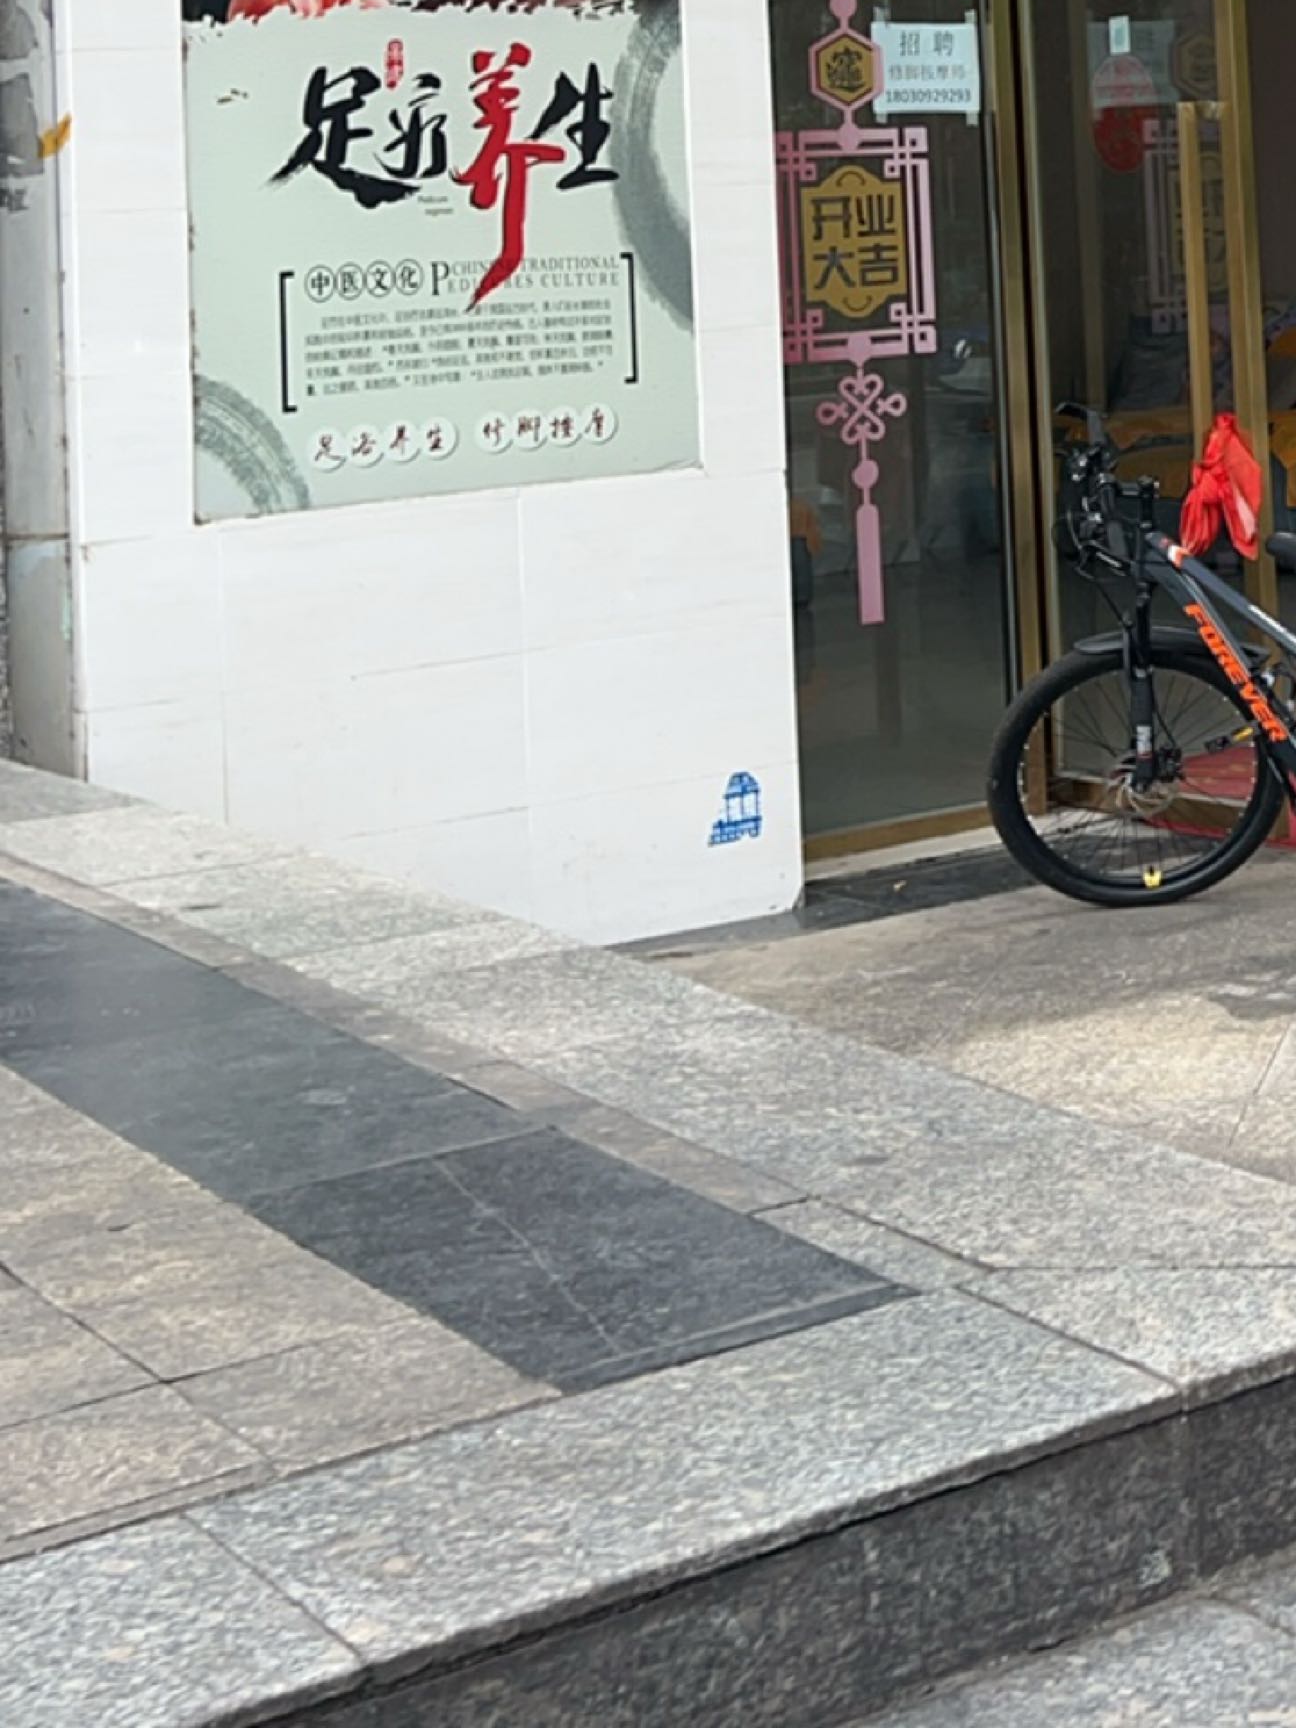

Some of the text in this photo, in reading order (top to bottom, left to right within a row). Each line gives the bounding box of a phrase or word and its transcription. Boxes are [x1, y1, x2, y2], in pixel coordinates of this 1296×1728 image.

[811, 194, 896, 240] 开业
[308, 261, 421, 299] 中医文化
[540, 272, 620, 289] CULTURE
[813, 243, 898, 290] 大吉
[1184, 602, 1288, 741] FOREVER
